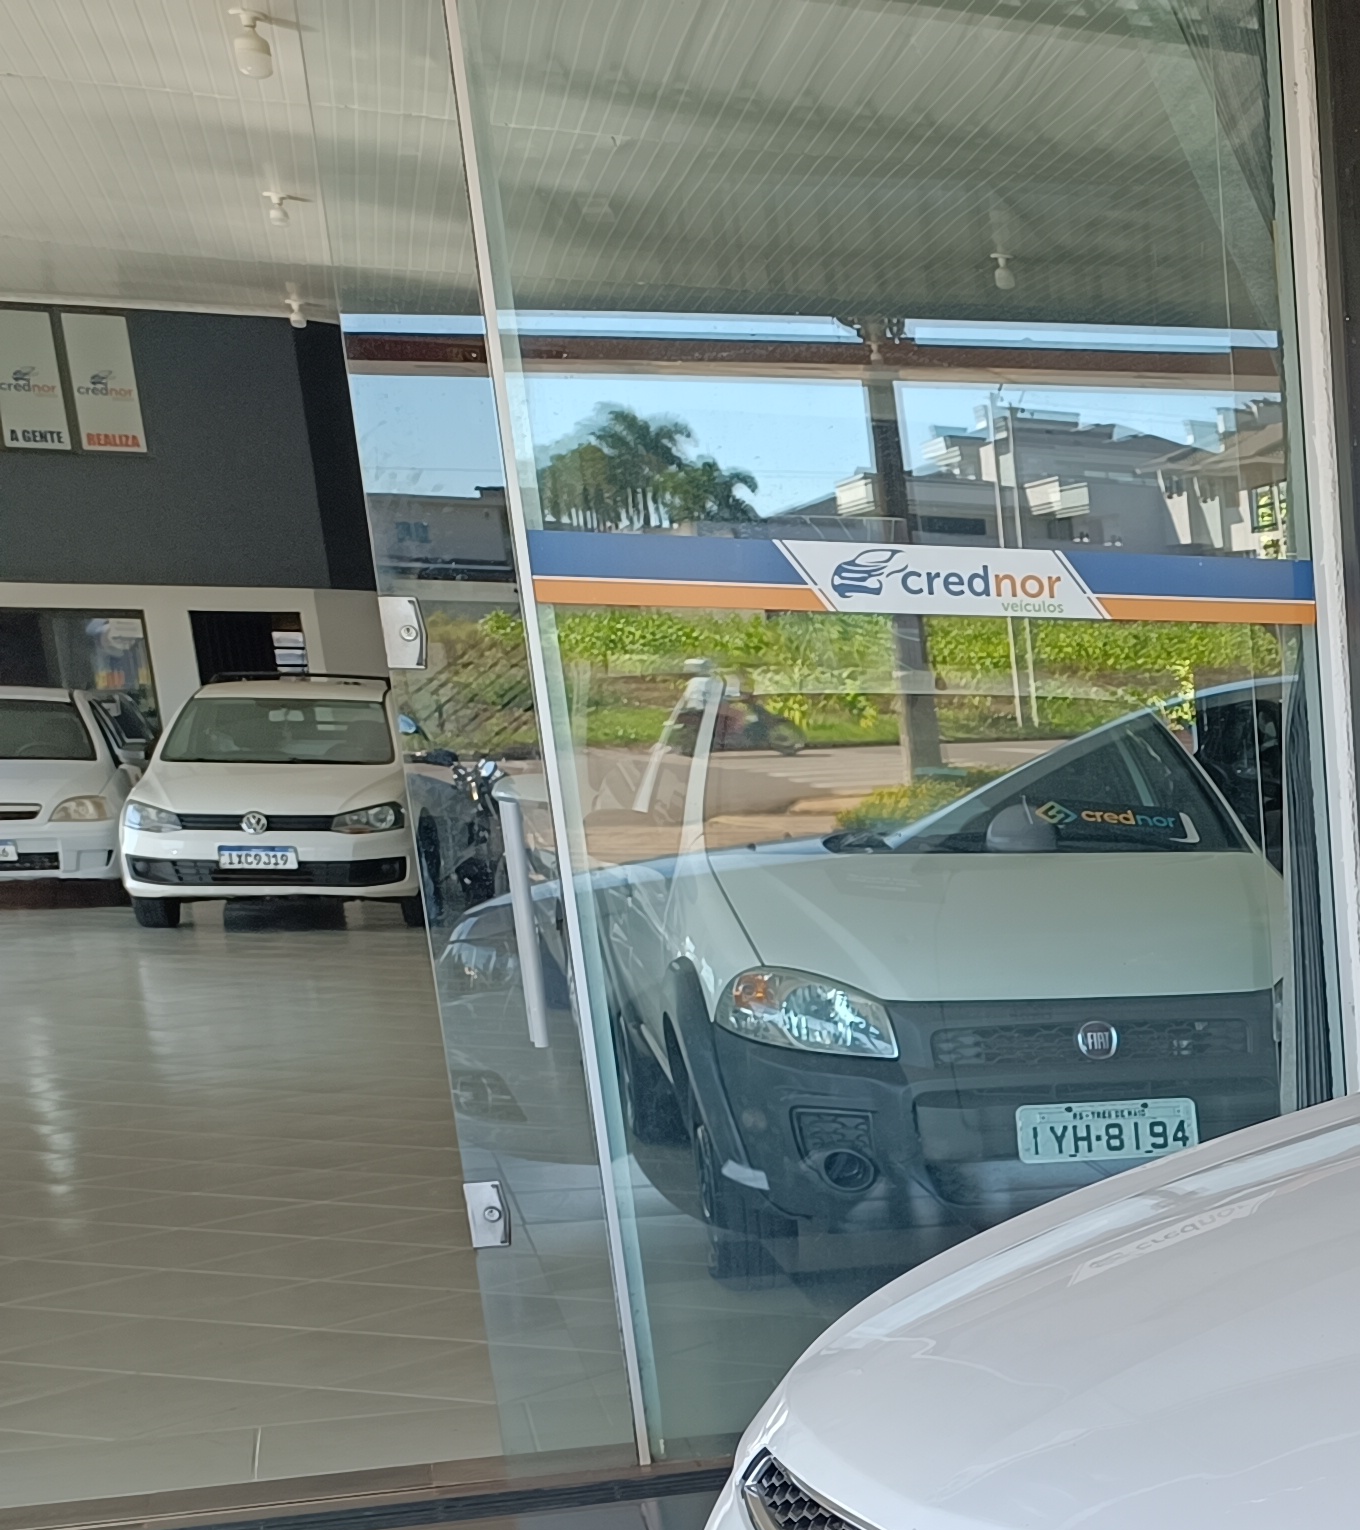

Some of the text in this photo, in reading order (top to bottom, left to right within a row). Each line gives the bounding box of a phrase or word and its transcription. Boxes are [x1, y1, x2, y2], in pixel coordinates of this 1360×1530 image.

[10, 429, 65, 444] A GENTE
[86, 432, 141, 448] REALIZA
[901, 564, 1062, 599] crednor
[1001, 600, 1064, 614] veículos
[1081, 810, 1177, 828] crednor
[1086, 1031, 1110, 1050] FIAT
